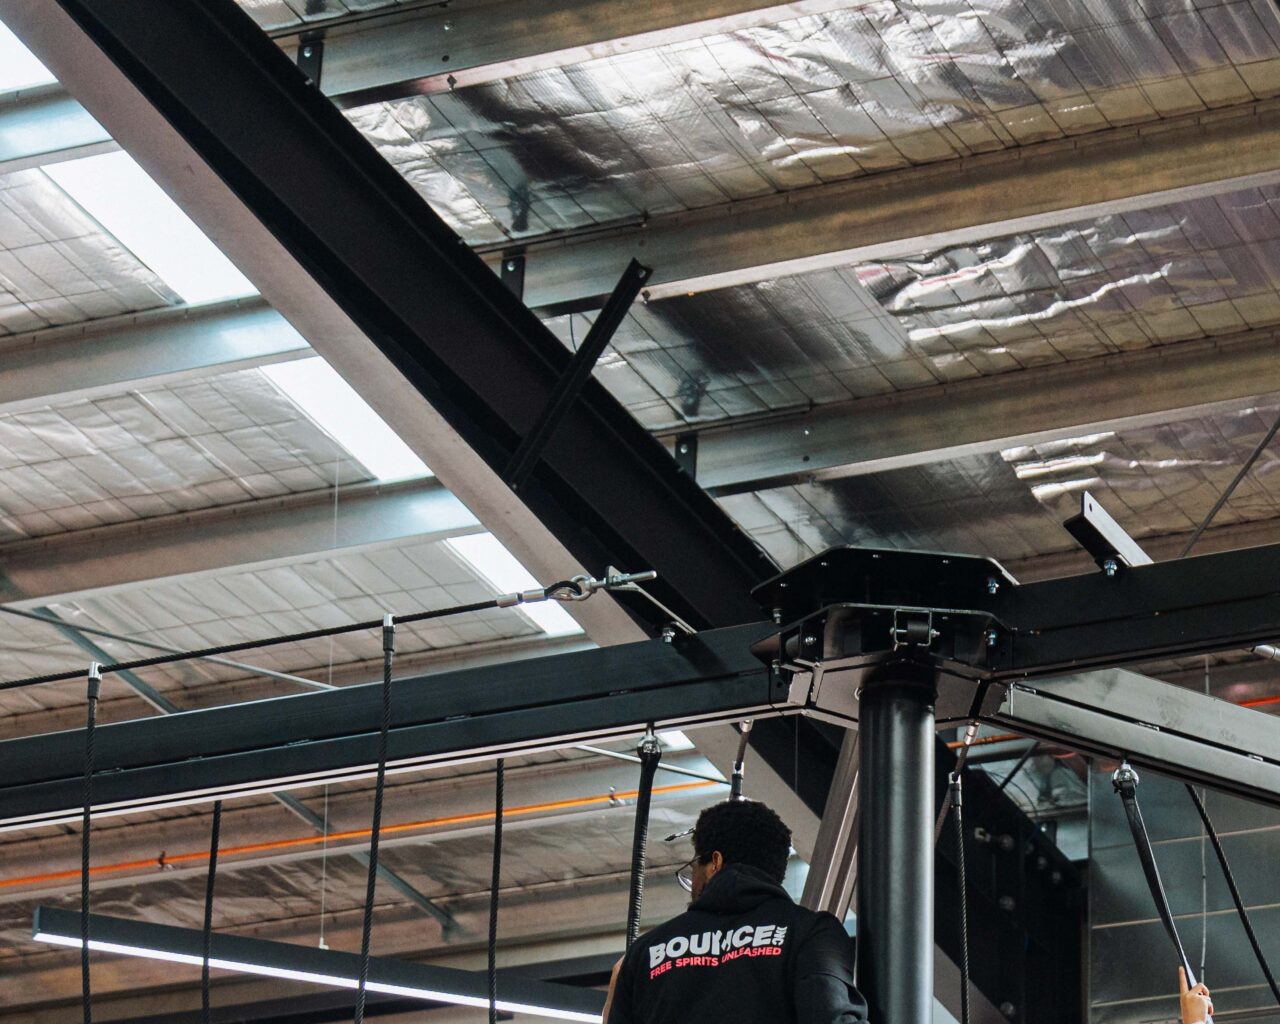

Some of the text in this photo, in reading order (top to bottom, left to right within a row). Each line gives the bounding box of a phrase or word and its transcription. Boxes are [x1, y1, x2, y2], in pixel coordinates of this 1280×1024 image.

[649, 925, 776, 969] BOUNCE
[772, 926, 788, 946] INC
[650, 946, 782, 980] FREE SPIRITS UNLEASHED
